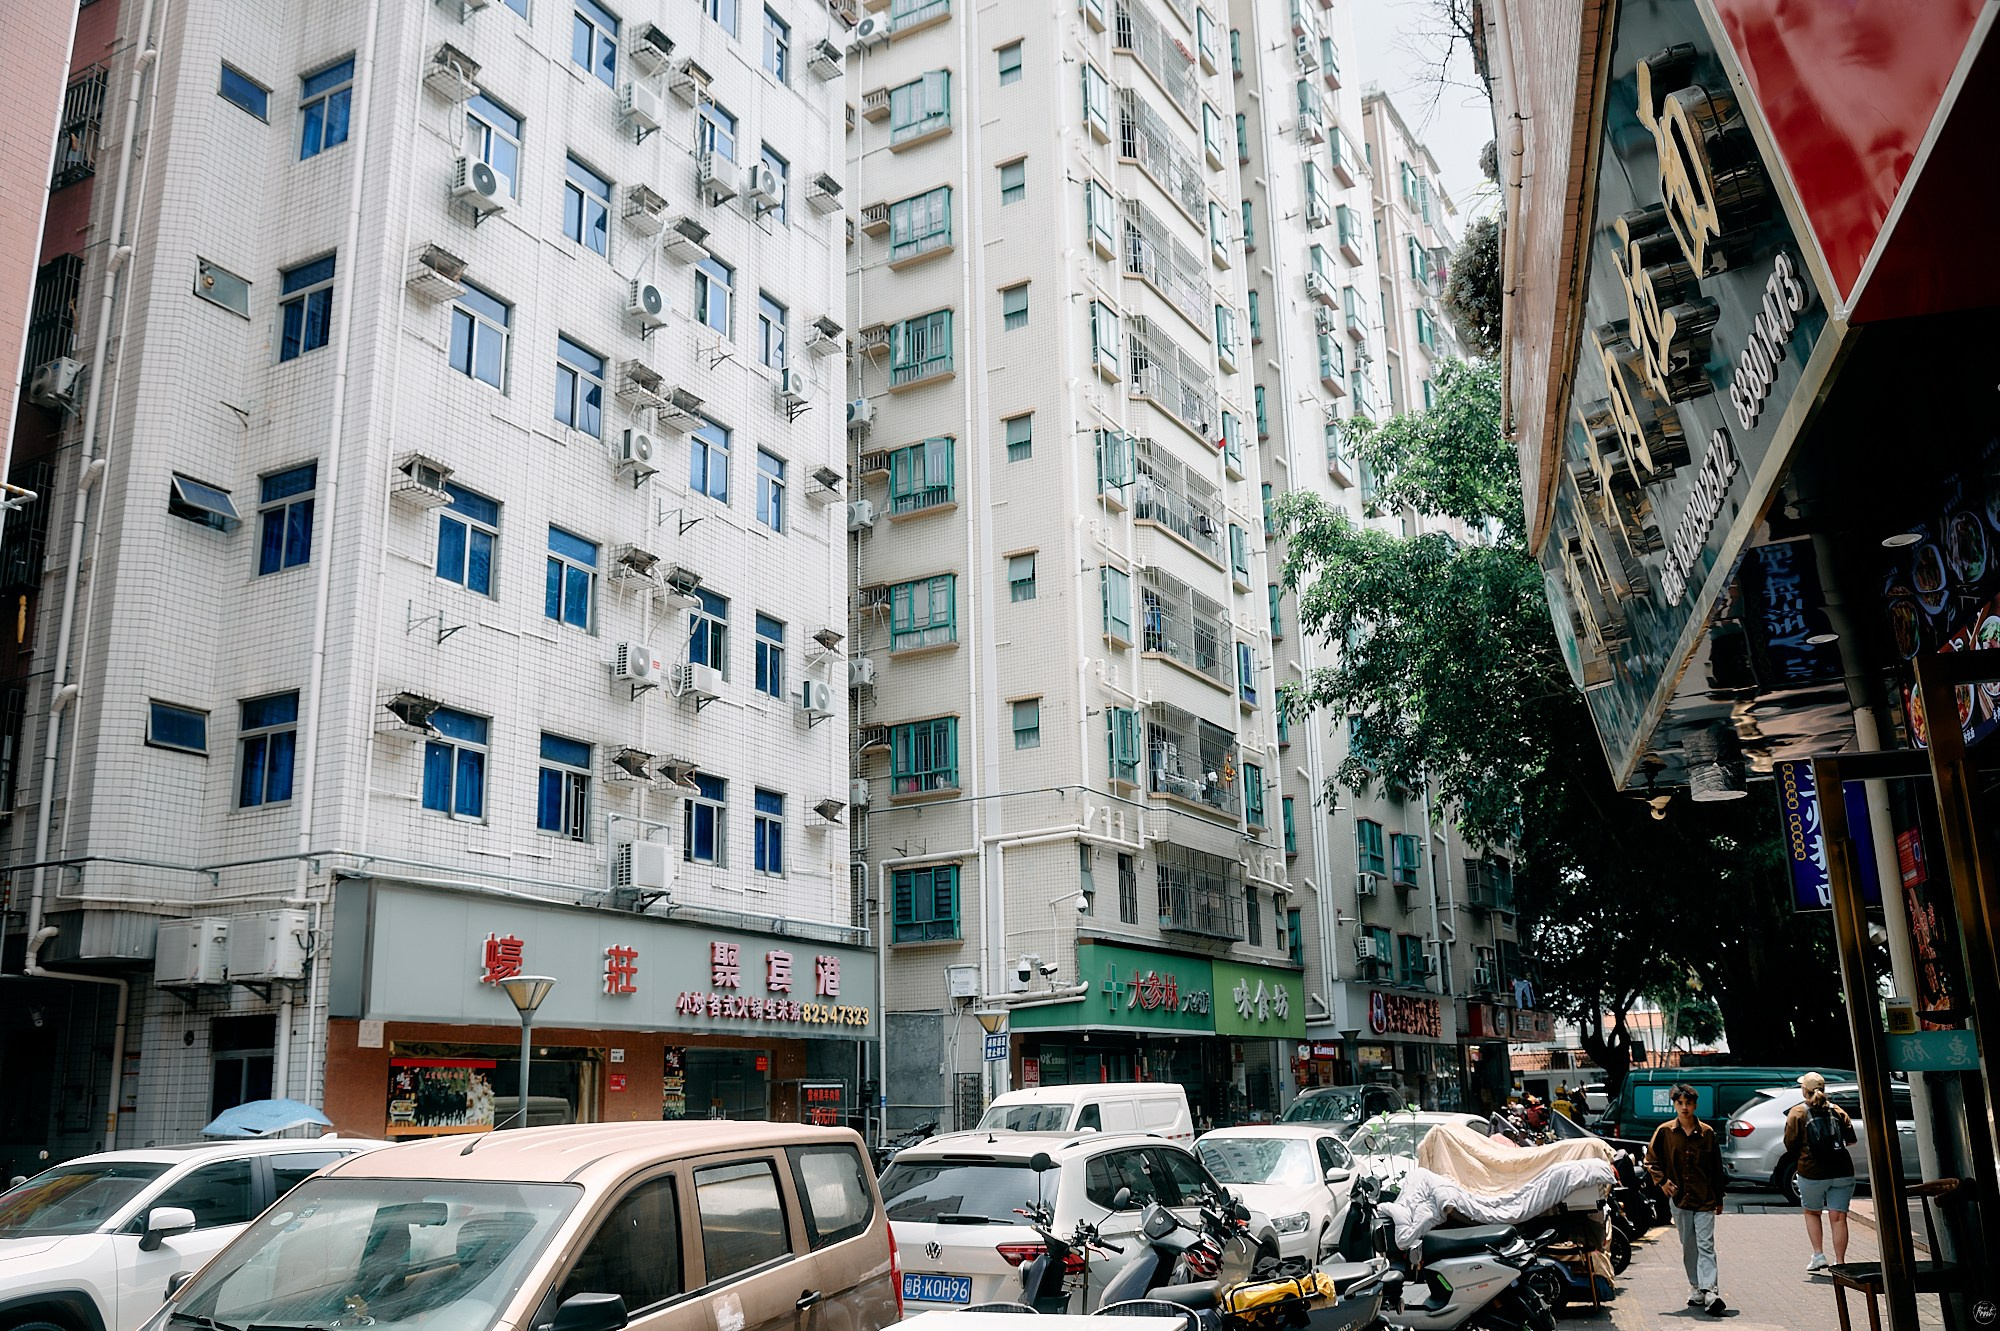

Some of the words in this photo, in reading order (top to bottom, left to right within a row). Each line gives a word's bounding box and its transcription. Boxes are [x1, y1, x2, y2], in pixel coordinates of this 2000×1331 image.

[1730, 254, 1803, 431] 83801473
[711, 942, 841, 996] 聚宾港
[1127, 971, 1180, 1011] 大参林
[803, 1003, 870, 1025] 82547323
[1233, 978, 1289, 1022] 味食坊
